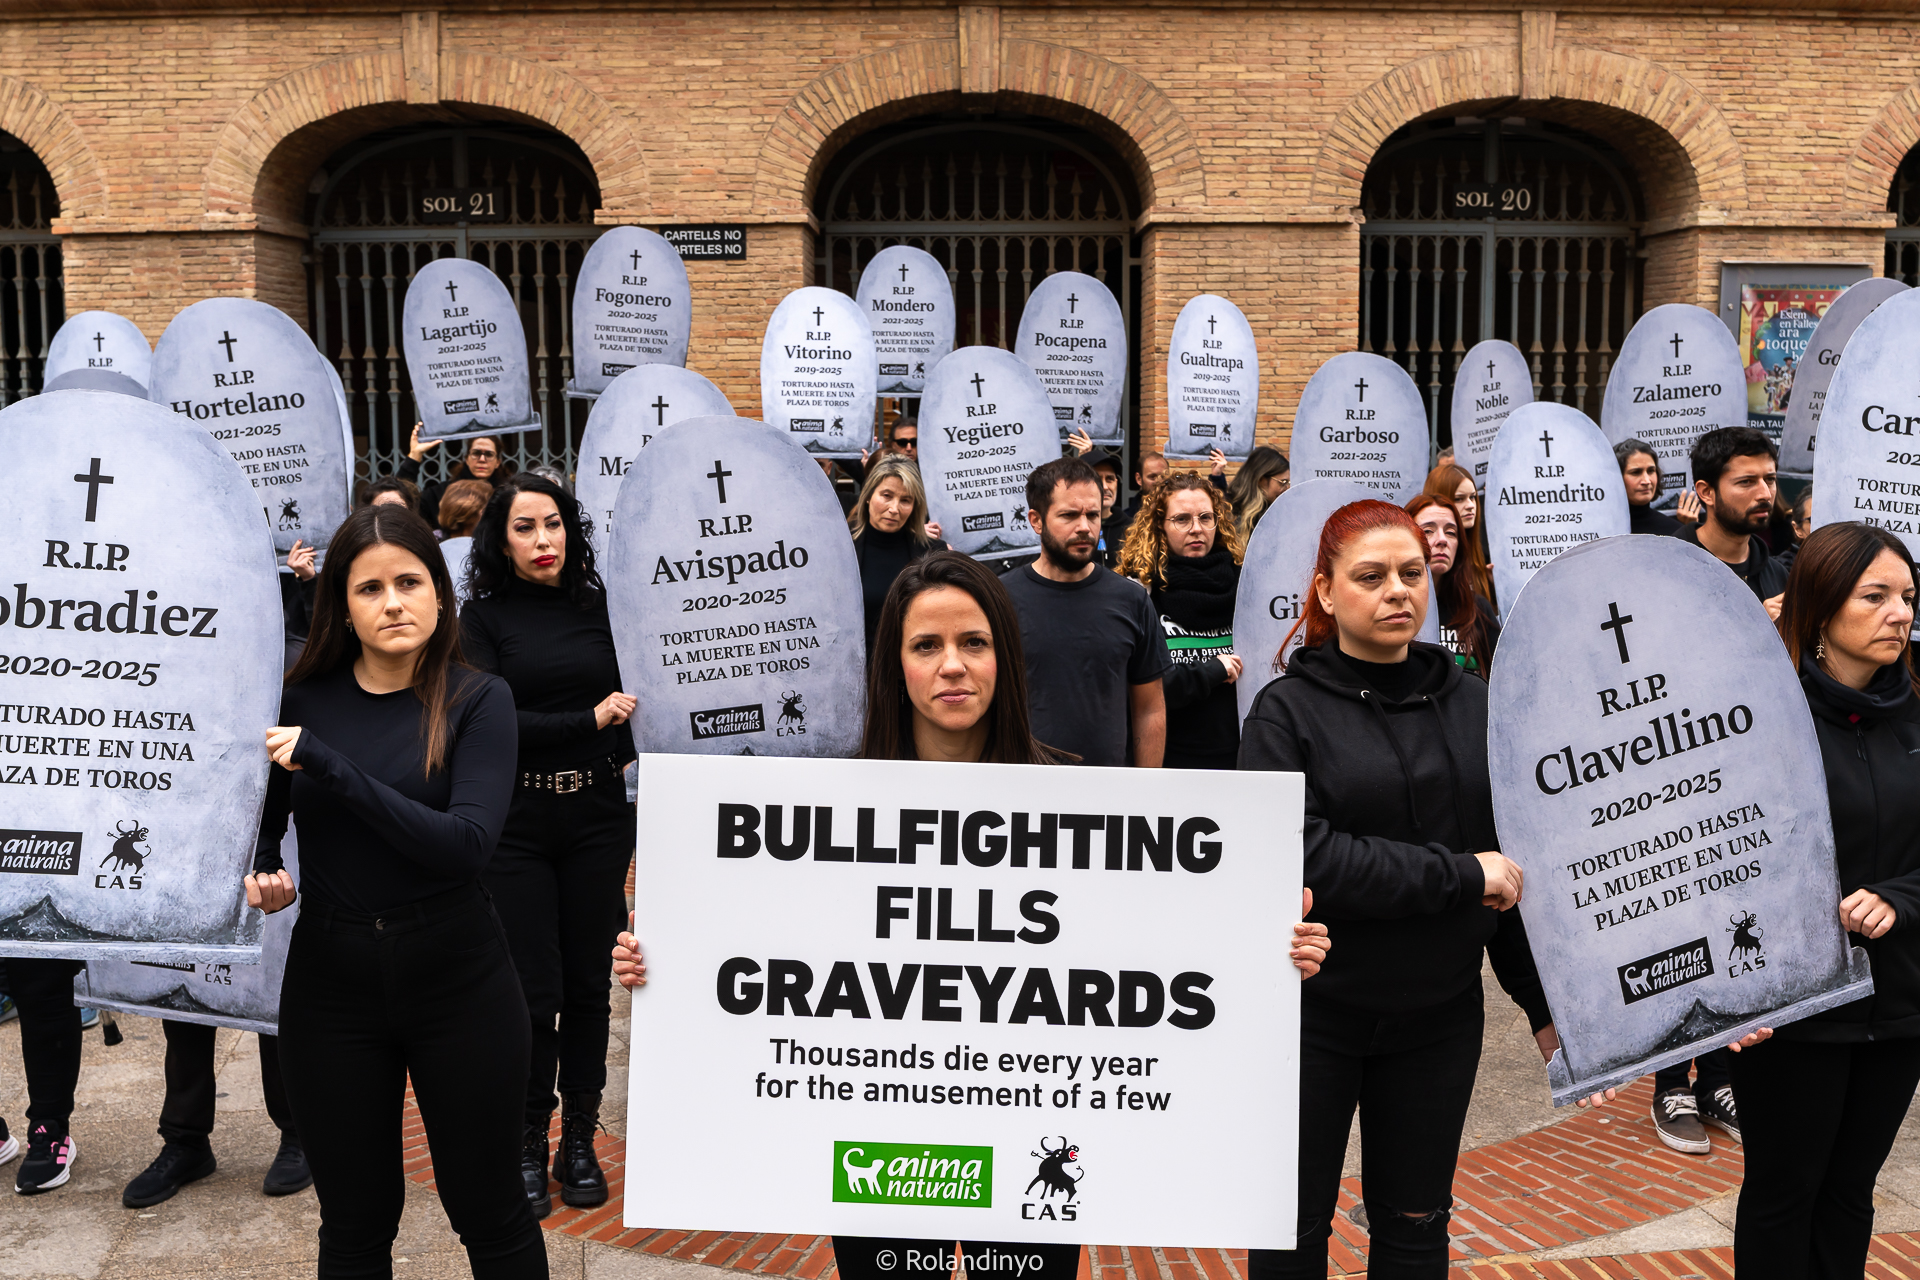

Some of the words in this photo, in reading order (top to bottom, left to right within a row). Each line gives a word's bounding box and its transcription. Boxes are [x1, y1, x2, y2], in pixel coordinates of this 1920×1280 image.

[423, 197, 462, 212] SOL
[470, 193, 494, 215] 21
[1456, 192, 1493, 206] SOL
[1501, 189, 1530, 210] 20
[724, 230, 742, 240] NO
[673, 244, 722, 255] ARTELES
[724, 244, 742, 254] NO
[622, 275, 647, 286] R.I.P.
[595, 288, 671, 307] Fogonero
[893, 286, 914, 294] R.I.P.
[443, 307, 468, 318] R.I.P.
[872, 299, 934, 311] Mondero
[607, 310, 657, 322] 2020-2025
[1060, 319, 1083, 328] R.I.P.
[421, 319, 496, 342] Lagartijo
[595, 324, 642, 333] TORTURADO
[643, 328, 668, 336] HASTA
[806, 331, 831, 340] R.I.P.
[438, 342, 486, 354] 2021-2025
[1035, 333, 1107, 351] Pocapena
[784, 345, 851, 360] Vitorino
[1046, 354, 1093, 363] 2020-2025
[88, 358, 112, 367] R.I.P.
[427, 359, 475, 370] TORTURADO
[476, 356, 502, 364] HASTA
[794, 366, 842, 375] 2019-2025
[1663, 364, 1691, 377] R.I.P.
[213, 370, 254, 387] R.I.P.
[1035, 368, 1079, 376] TORTURADO
[1633, 384, 1721, 403] Zalamero
[966, 403, 996, 417] R.I.P.
[1346, 409, 1375, 420] R.I.P.
[1649, 406, 1706, 419] 2020-2025
[210, 423, 281, 440] 021-2025
[943, 422, 1023, 445] Yegüero
[1320, 426, 1399, 443] Garboso
[1636, 426, 1690, 438] TORTURADO
[266, 444, 306, 456] HASTA
[957, 445, 1016, 459] 2020-2025
[1330, 452, 1387, 462] 2021-2025
[945, 466, 1001, 479] TORTURADO
[1003, 462, 1033, 472] HASTA
[1372, 470, 1400, 478] HASTA
[1534, 465, 1564, 478] R.I.P.
[261, 473, 302, 486] TOROS
[946, 483, 957, 491] LA
[959, 478, 998, 489] MUERTE
[1000, 475, 1013, 483] EN
[1016, 474, 1028, 483] UN
[954, 491, 982, 501] PLAZA
[985, 489, 996, 497] DE
[1498, 483, 1604, 505] Almendrito
[698, 514, 752, 537] R.I.P.
[1525, 513, 1582, 523] 2021-2025
[278, 523, 301, 531] CAS
[1510, 534, 1567, 544] TORTURADO
[1570, 532, 1603, 543] HASTA
[42, 539, 129, 571] R.I.P.
[1511, 549, 1523, 557] LA
[651, 540, 808, 585] Avispado
[682, 588, 786, 612] 2020-2025
[660, 623, 759, 646] TORTURADO
[764, 616, 817, 634] HASTA
[661, 653, 683, 666] LA
[686, 644, 755, 663] MUERTE
[759, 640, 780, 654] EN
[785, 636, 820, 650] UNA
[1171, 649, 1184, 658] OR
[1202, 647, 1233, 656] DEFENS
[676, 667, 727, 684] PLAZA
[730, 664, 753, 678] DE
[756, 656, 810, 674] TOROS
[1596, 673, 1667, 717] R.I.P.
[0, 704, 105, 726] TURADO
[112, 710, 195, 731] HASTA
[716, 710, 759, 724] anima
[717, 720, 760, 734] naturalis
[776, 725, 806, 737] CAS
[97, 739, 134, 758] EN
[141, 741, 194, 761] UNA
[1535, 704, 1753, 795] Clavellino
[44, 767, 79, 786] DE
[87, 769, 171, 790] TOROS
[1591, 768, 1721, 827] 2020-2025
[3, 835, 74, 856] anima
[717, 803, 1222, 873] BULLFIGHTING
[1567, 826, 1693, 880] TORTURADO
[1697, 804, 1765, 838] HASTA
[2, 853, 72, 870] naturalis
[1572, 887, 1601, 909] LA
[1603, 855, 1690, 899] MUERTE
[1694, 843, 1722, 868] EN
[1727, 830, 1772, 855] UNA
[95, 875, 142, 889] CAS
[1594, 896, 1659, 931] PLAZA
[1661, 884, 1691, 907] DE
[1693, 860, 1761, 895] TOROS
[876, 885, 1060, 944] FILLS
[1651, 947, 1704, 977] anima
[1728, 955, 1765, 978] CAS
[205, 973, 232, 985] CAS
[1654, 961, 1708, 990] naturalis
[717, 957, 1215, 1030] GRAVEYARDS
[769, 1038, 934, 1069] Thousands
[944, 1045, 988, 1071] die
[998, 1053, 1082, 1080] every
[1091, 1056, 1158, 1080] year
[756, 1072, 799, 1098] for
[807, 1074, 853, 1100] the
[864, 1083, 1042, 1107] amusement
[1052, 1083, 1081, 1108] of
[1090, 1090, 1105, 1109] a
[1116, 1084, 1171, 1110] few
[886, 1151, 983, 1180] anima
[886, 1178, 982, 1200] naturalis
[1021, 1203, 1076, 1221] CAS
